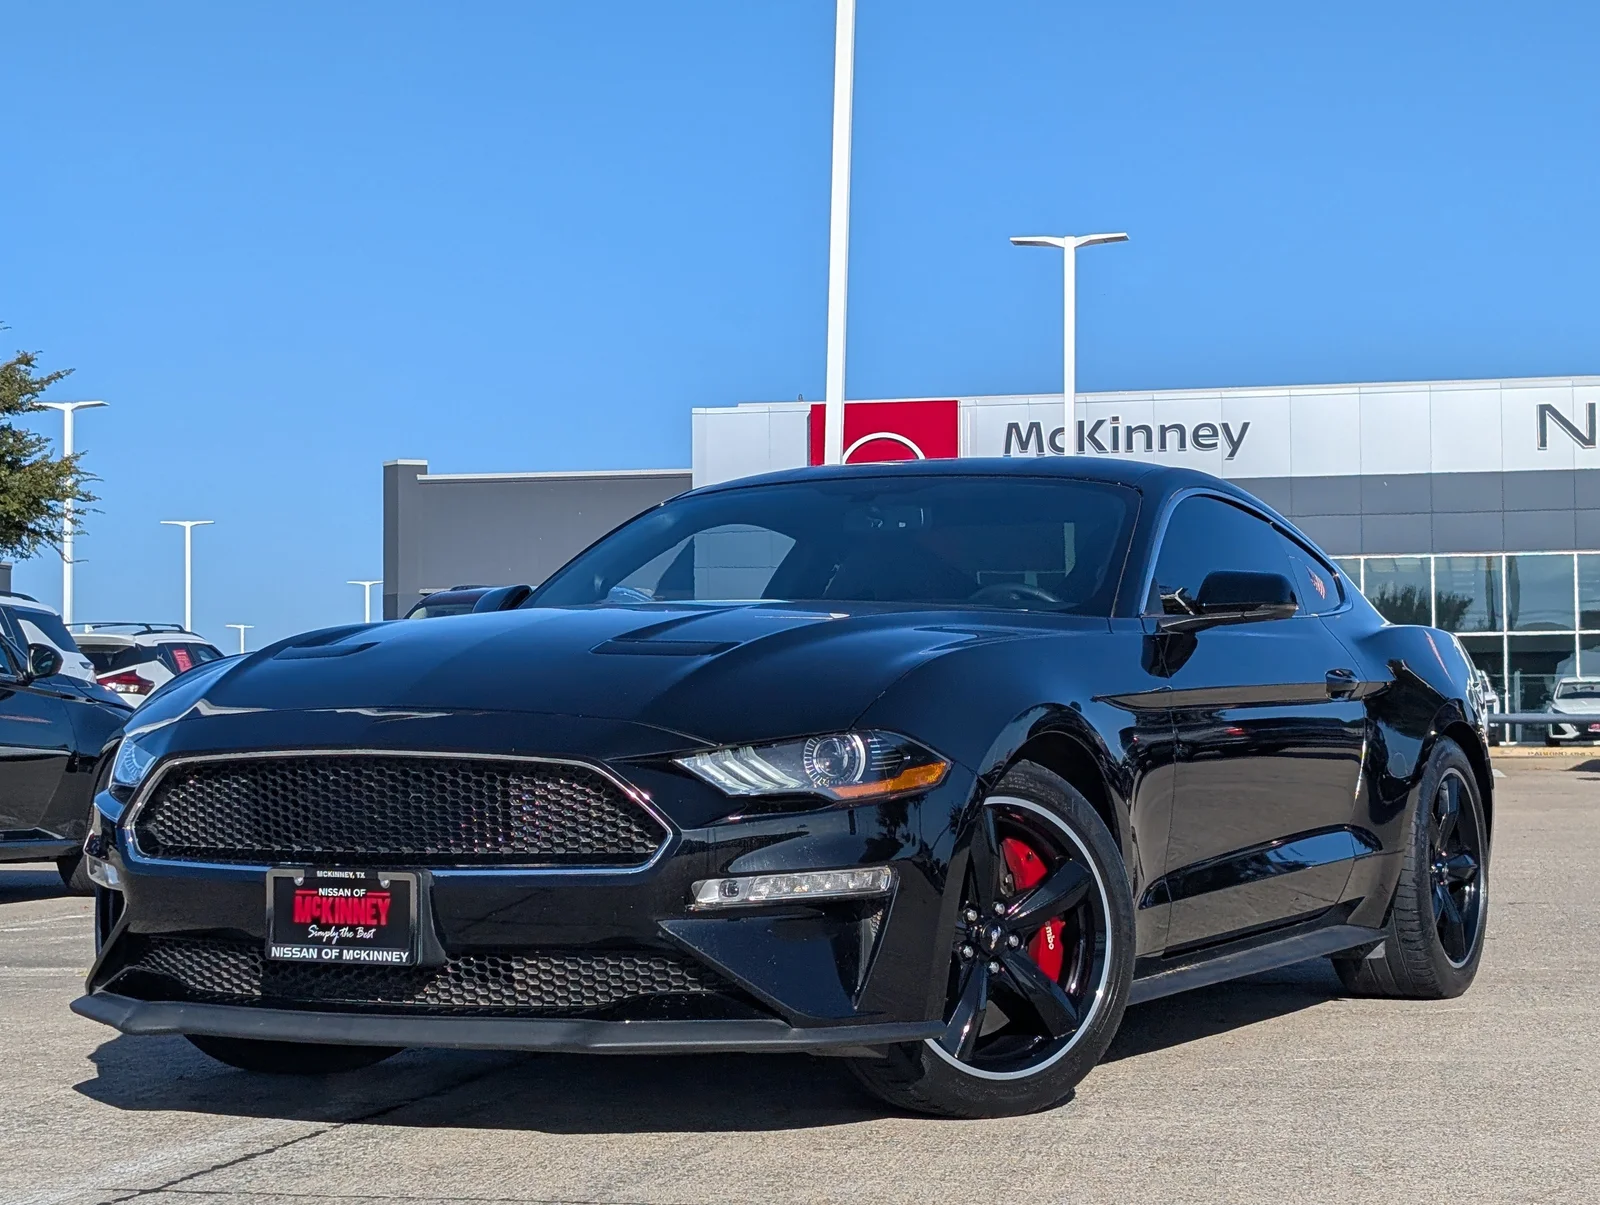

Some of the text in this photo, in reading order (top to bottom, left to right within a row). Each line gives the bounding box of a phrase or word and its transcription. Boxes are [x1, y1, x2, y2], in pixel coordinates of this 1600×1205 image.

[1003, 415, 1251, 461] McKinney
[356, 871, 366, 879] TX
[318, 887, 367, 897] NISSAN OF
[308, 924, 376, 944] Simply the Best
[271, 946, 317, 959] NISSAN
[321, 949, 340, 960] OF
